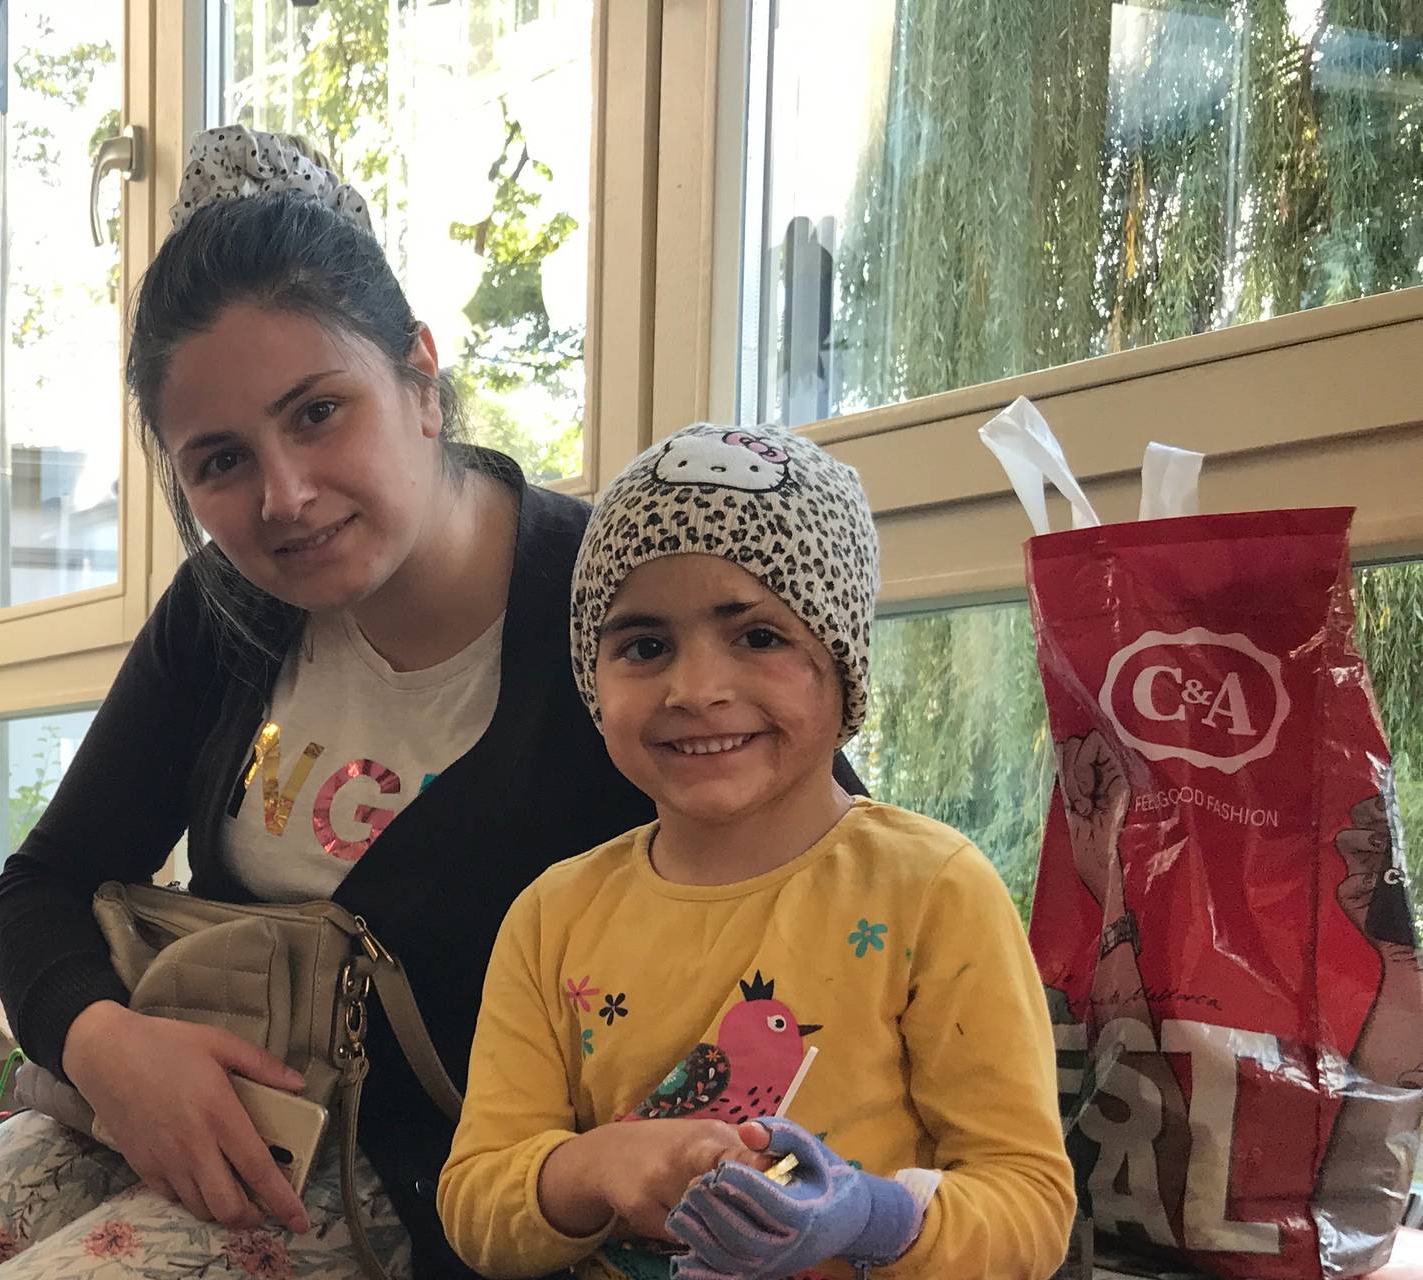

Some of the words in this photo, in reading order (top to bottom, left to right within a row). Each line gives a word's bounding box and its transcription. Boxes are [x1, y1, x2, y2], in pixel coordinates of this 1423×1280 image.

[1133, 665, 1257, 736] C&A
[1157, 786, 1204, 808] GOOD
[1207, 795, 1279, 828] FASHION
